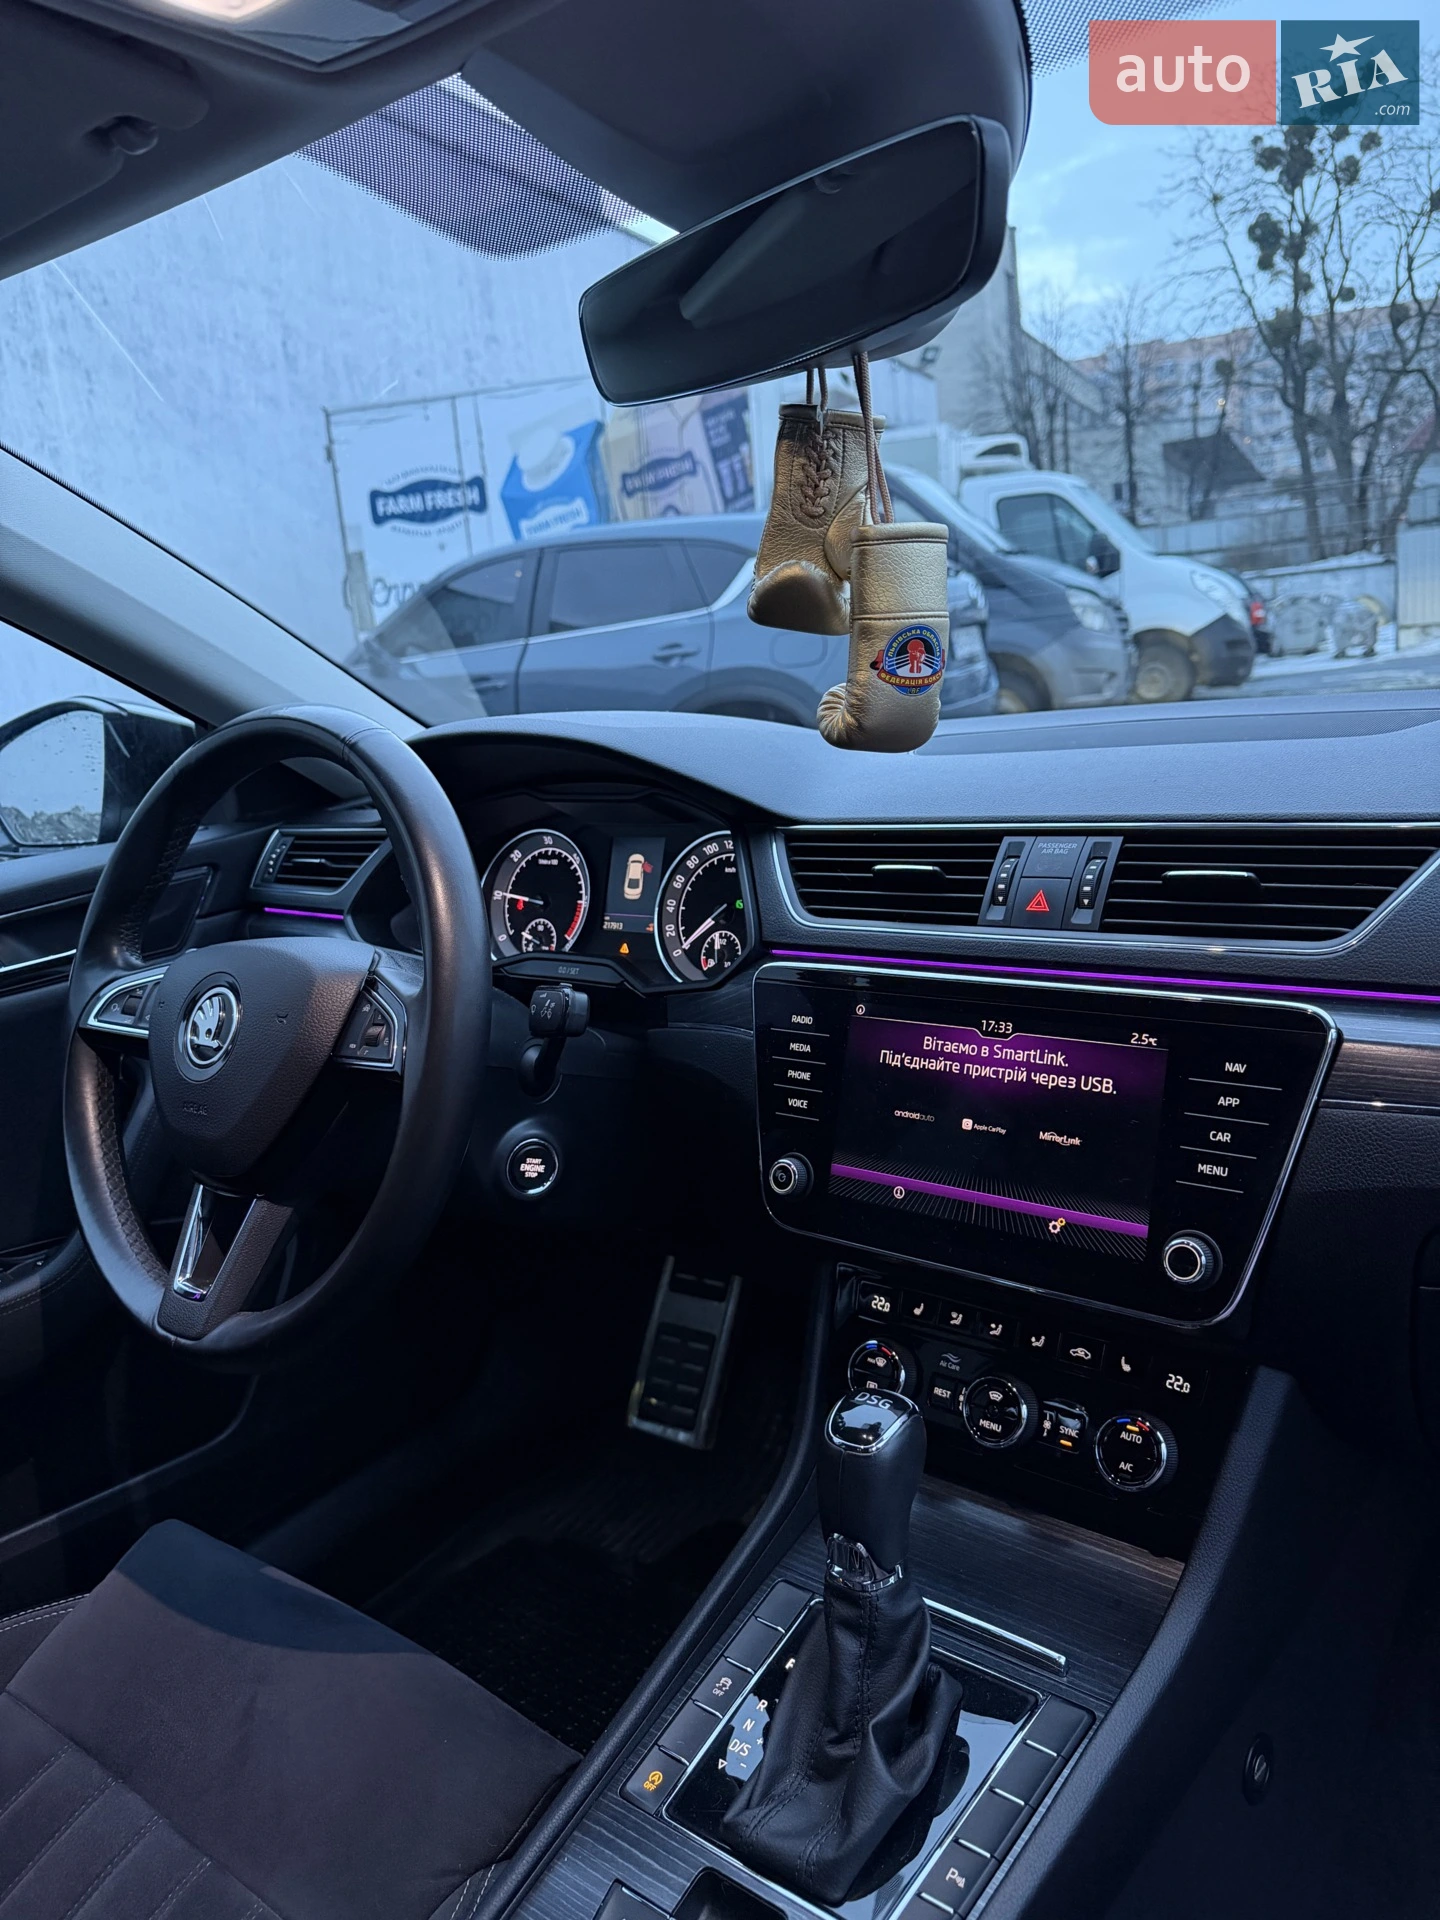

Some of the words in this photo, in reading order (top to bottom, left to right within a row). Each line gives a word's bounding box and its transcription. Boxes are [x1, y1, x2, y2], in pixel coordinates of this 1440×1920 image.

[375, 492, 425, 517] FARM
[423, 485, 480, 511] FRESH
[888, 629, 921, 657] ЛЬВІВСЬКА
[880, 672, 923, 685] ФЕДЕРАЦІЯ
[702, 842, 720, 855] 100
[510, 849, 522, 862] 20
[686, 855, 700, 869] 80
[672, 874, 685, 889] 60
[494, 890, 503, 900] 10
[666, 899, 676, 913] 40
[665, 924, 675, 937] 20
[498, 934, 507, 942] 0
[672, 948, 682, 957] 0
[791, 1014, 813, 1025] RADIO
[981, 1019, 1013, 1034] 17:33
[789, 1042, 812, 1053] MEDIA
[923, 1035, 978, 1056] Вітаємо
[980, 1045, 990, 1057] в
[993, 1043, 1069, 1068] SmartLink.
[1224, 1062, 1248, 1074] NAV
[787, 1069, 812, 1081] PHONE
[963, 1062, 1027, 1084] пристрій
[1031, 1071, 1077, 1090] через
[1080, 1075, 1118, 1095] USB.
[787, 1098, 809, 1109] VOICE
[1217, 1096, 1241, 1108] APP
[973, 1122, 988, 1132] Apple
[988, 1124, 1007, 1135] CarPlay
[1039, 1131, 1082, 1147] MirrorLink
[1209, 1130, 1232, 1144] CAR
[520, 1163, 545, 1172] ENGINE
[1197, 1163, 1229, 1178] MENU
[933, 1386, 952, 1400] REST
[854, 1391, 894, 1410] DSG
[979, 1418, 1002, 1433] MENU
[1059, 1425, 1079, 1439] SYNC
[1120, 1431, 1143, 1444] AUTO
[1119, 1461, 1134, 1473] A/C
[712, 1687, 725, 1697] OFF
[756, 1699, 768, 1712] R
[743, 1718, 755, 1731] N
[728, 1738, 751, 1757] D/S
[643, 1780, 657, 1792] OFF
